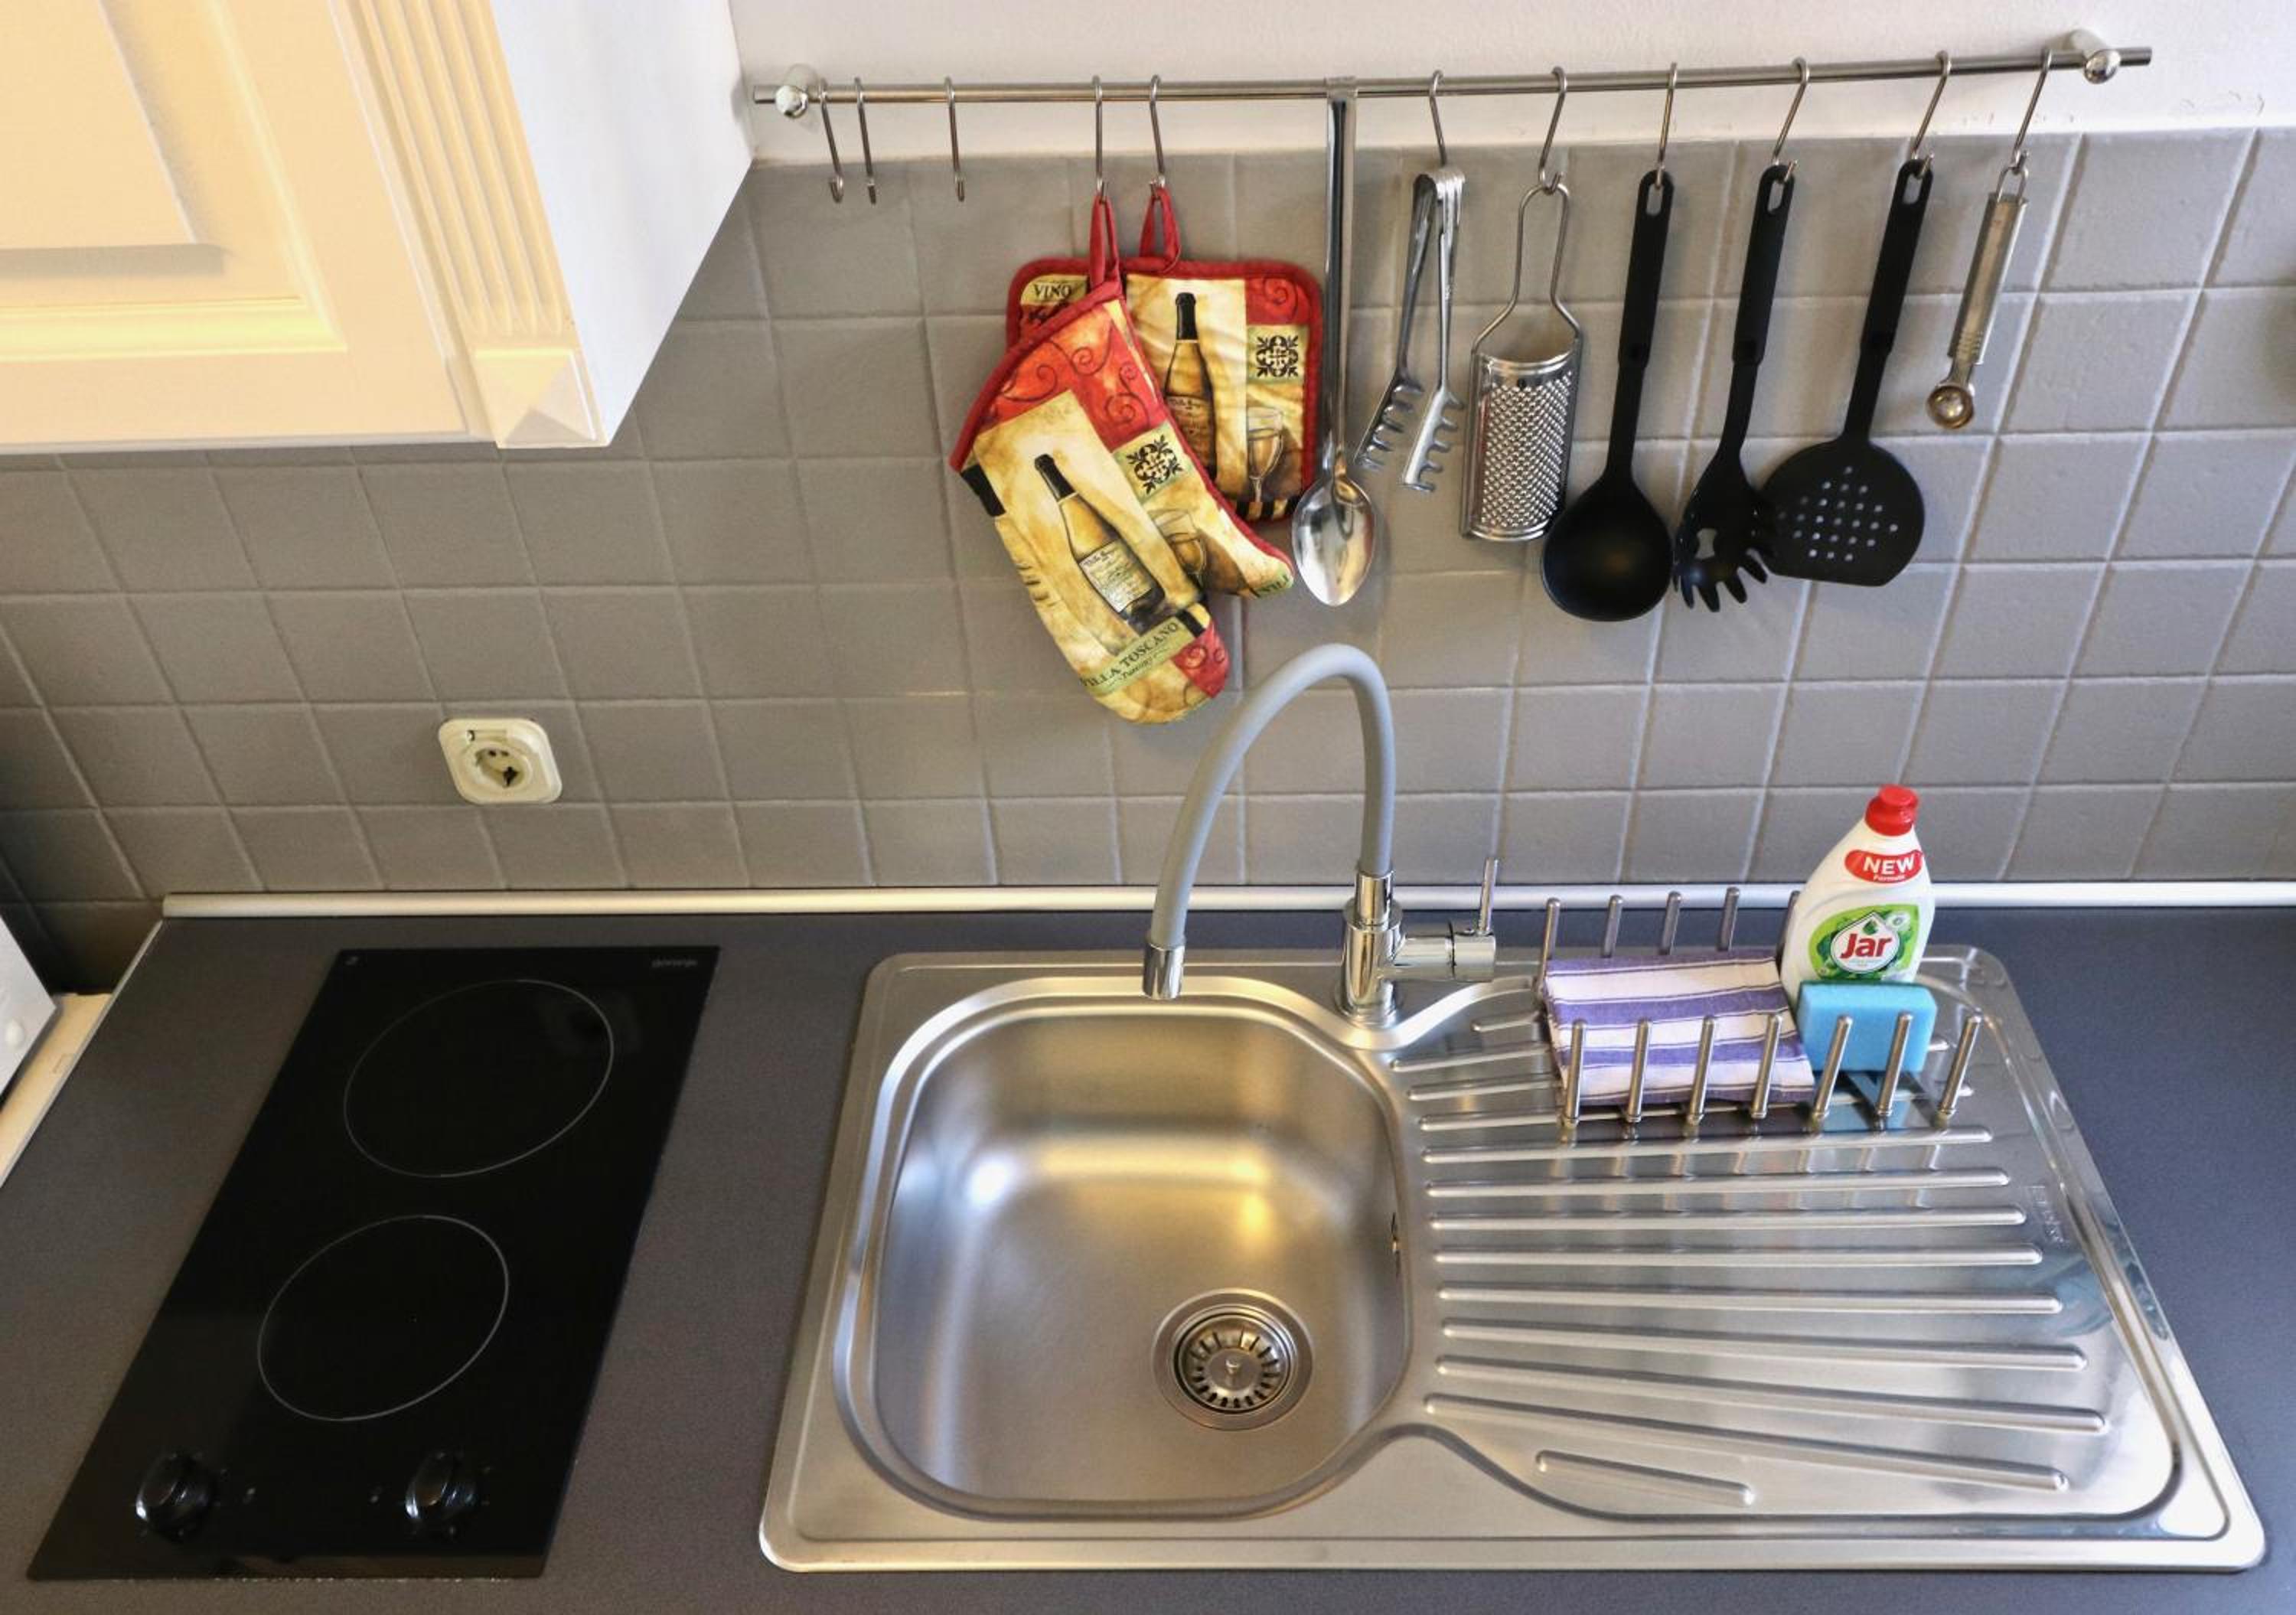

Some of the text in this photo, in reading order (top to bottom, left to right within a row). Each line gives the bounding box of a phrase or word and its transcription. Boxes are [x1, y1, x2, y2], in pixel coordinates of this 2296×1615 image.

[1033, 284, 1073, 299] VINO
[1119, 622, 1178, 667] TOSCANO
[1863, 854, 1915, 875] NEW
[1840, 932, 1893, 959] Jar
